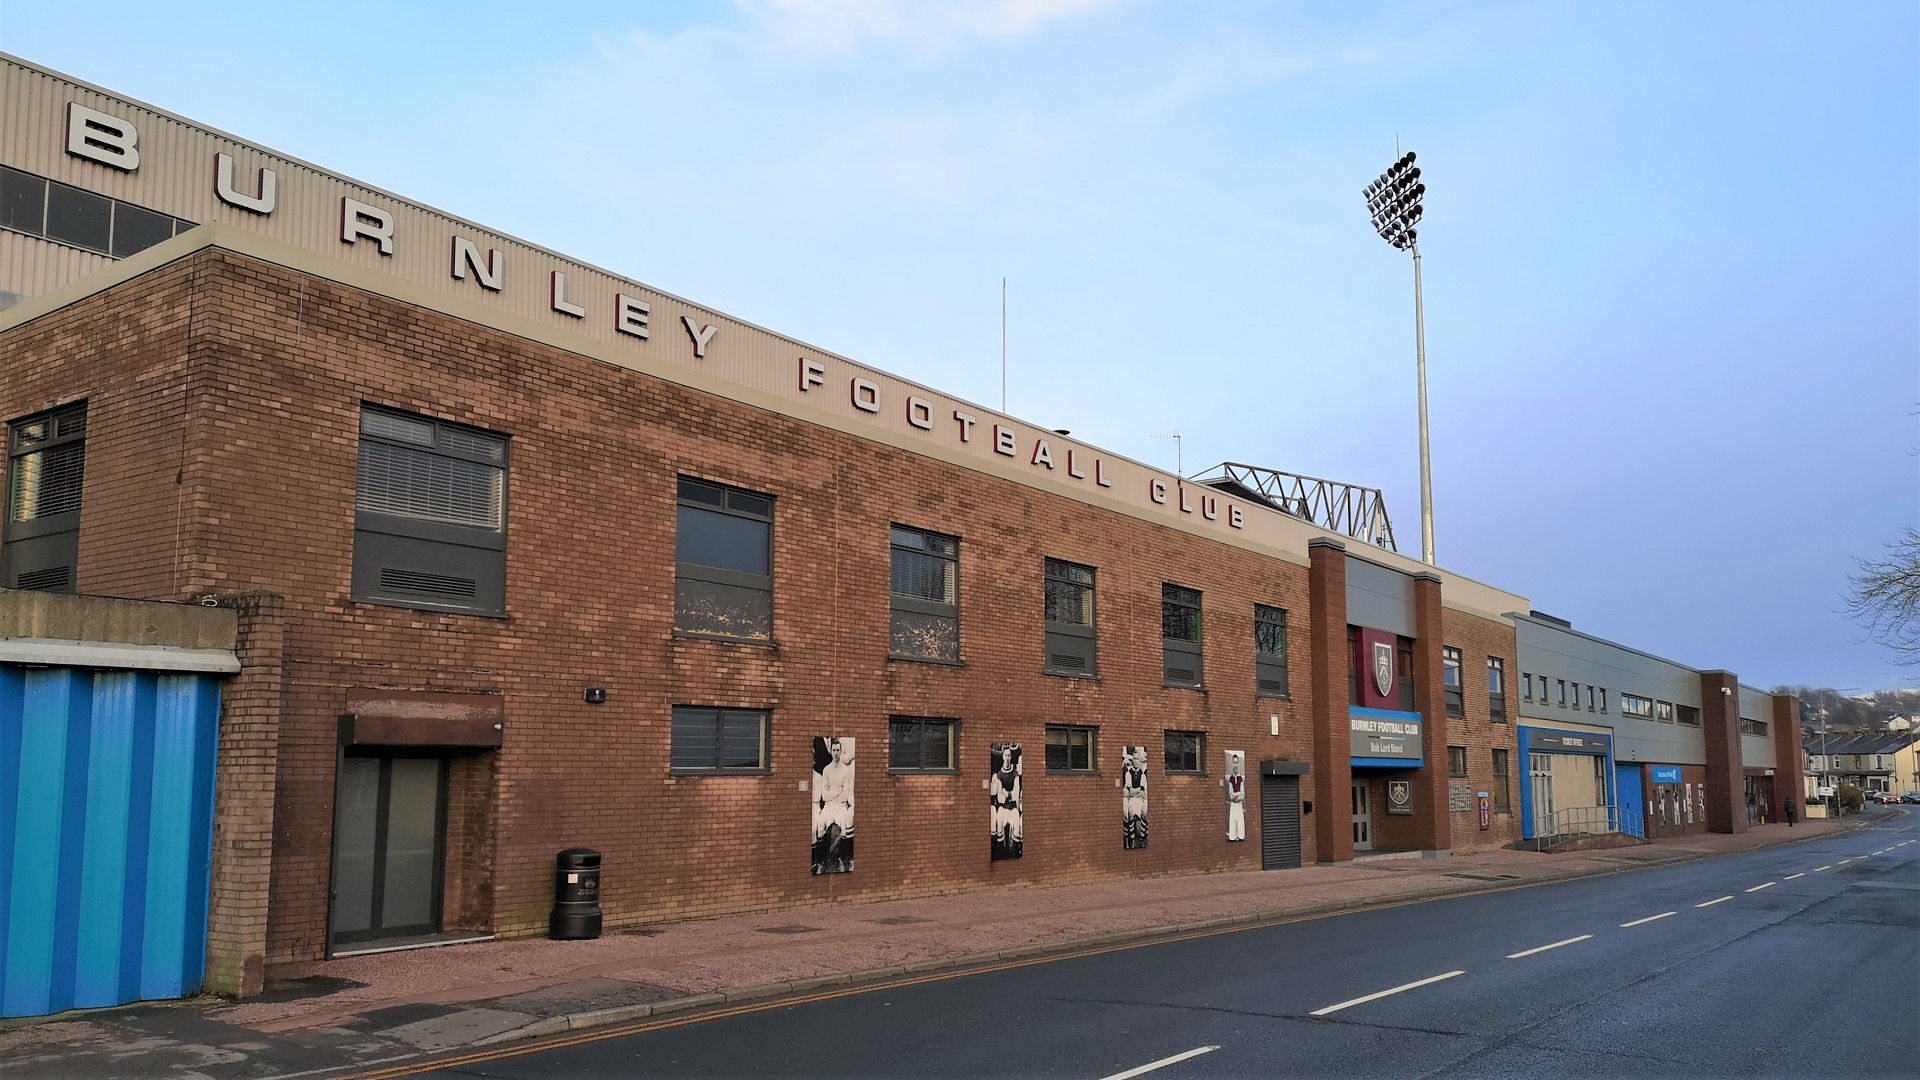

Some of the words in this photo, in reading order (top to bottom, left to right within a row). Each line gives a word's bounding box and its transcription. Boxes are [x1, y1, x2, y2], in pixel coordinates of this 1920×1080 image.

[65, 101, 718, 357] BURNLEY
[799, 357, 1112, 488] FOOTBALL
[1150, 477, 1244, 529] CLUB
[1351, 719, 1377, 732] BURNLEY
[1378, 721, 1404, 734] FOOTBALL
[1405, 724, 1418, 735] CLUB
[1371, 742, 1380, 752] Bob
[1380, 743, 1390, 753] Lord
[1391, 743, 1403, 753] Stand
[1562, 737, 1573, 746] TICKET
